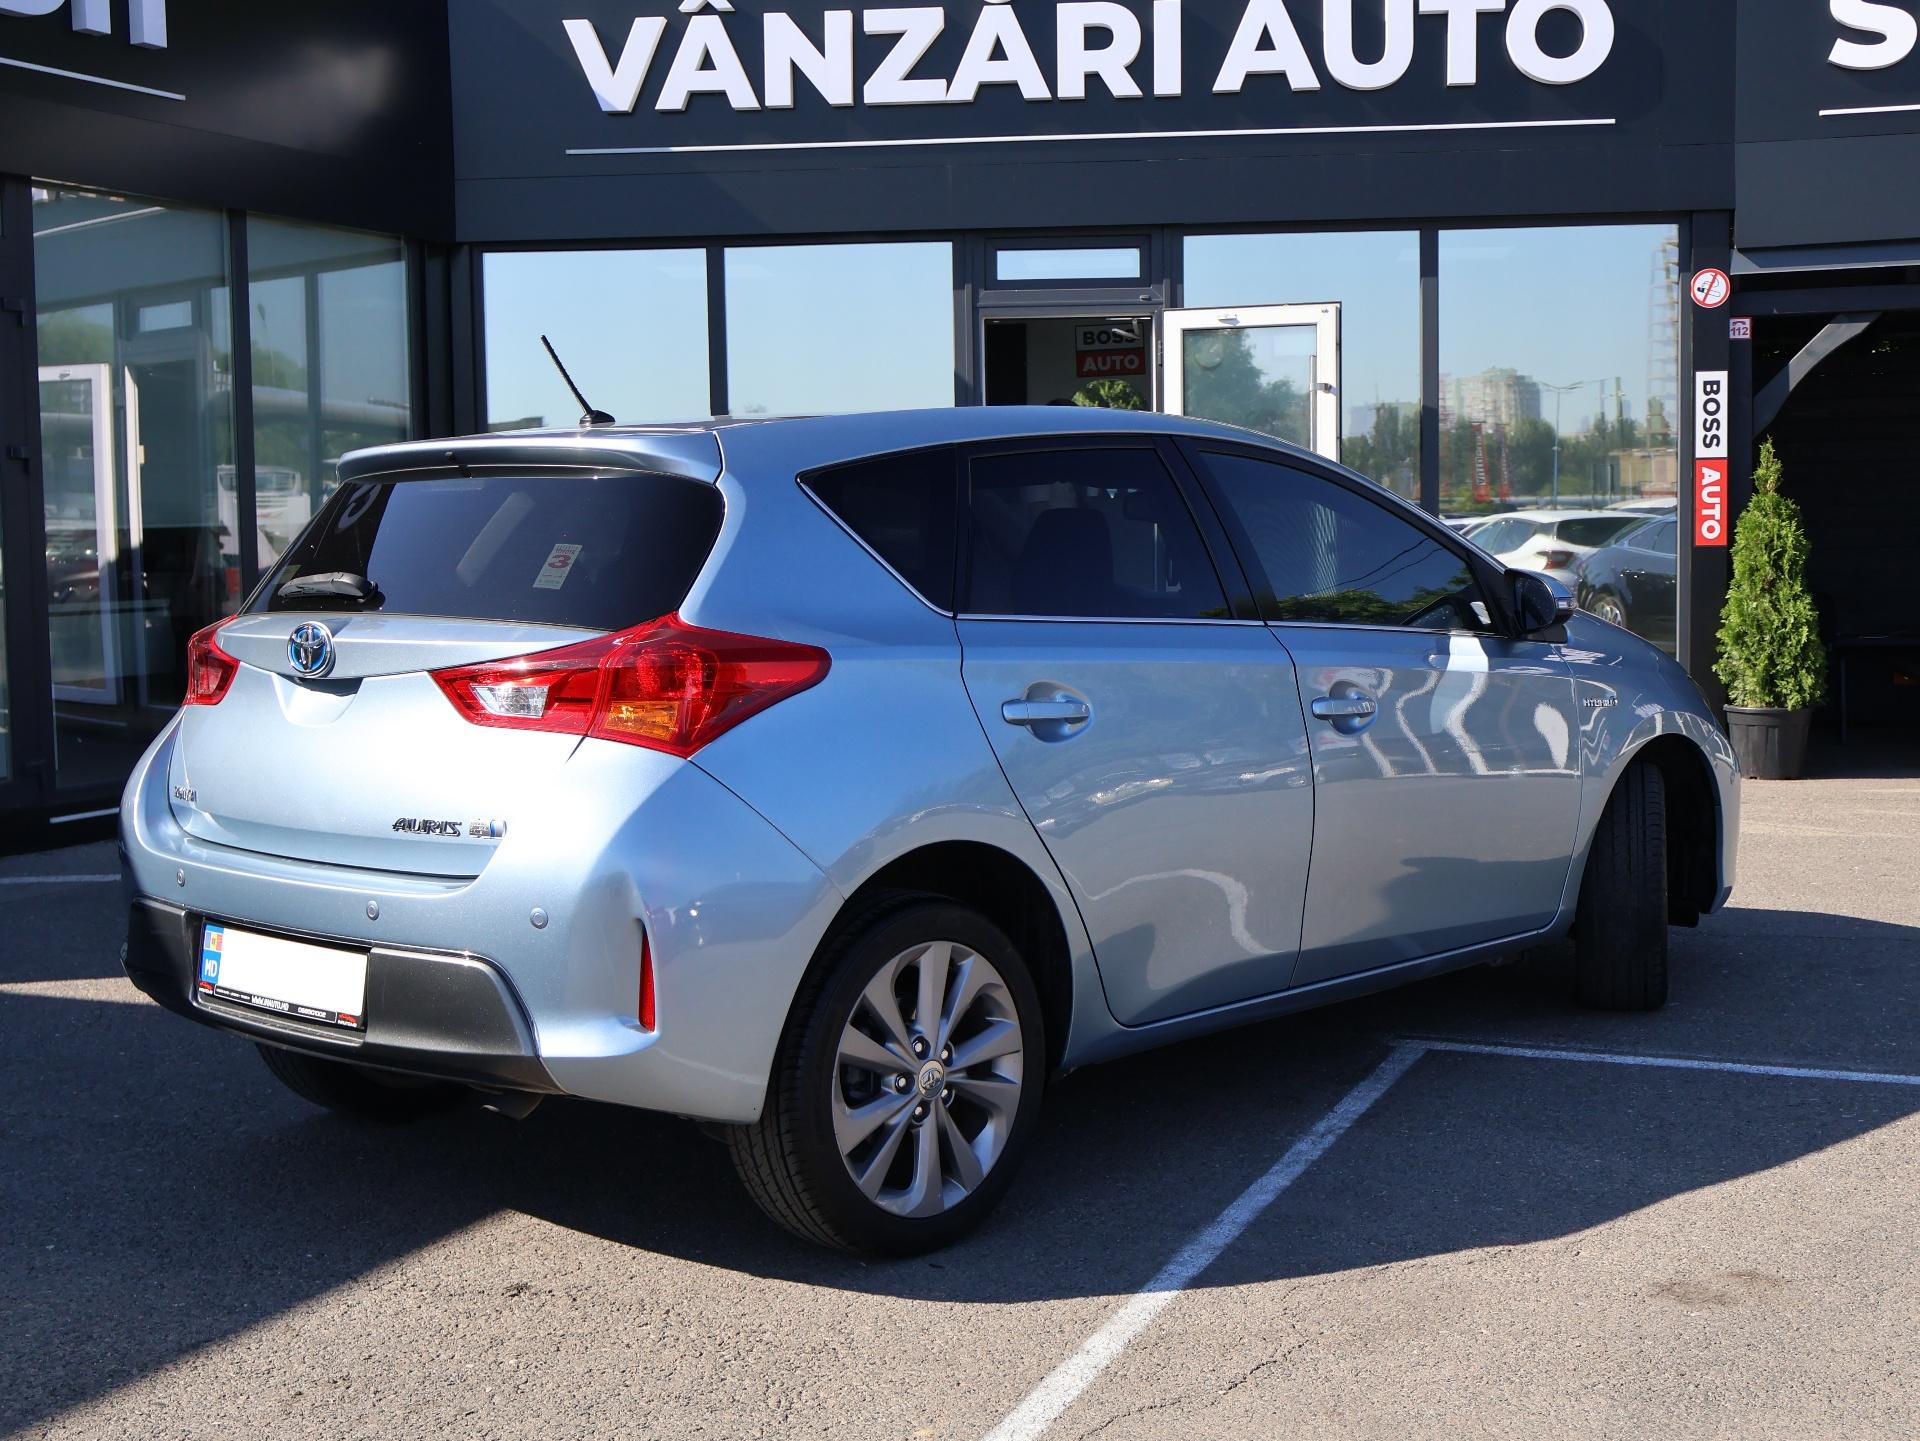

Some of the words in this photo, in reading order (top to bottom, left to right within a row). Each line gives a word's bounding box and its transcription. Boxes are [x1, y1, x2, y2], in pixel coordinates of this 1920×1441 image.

[1212, 0, 1615, 93] AUTO
[1730, 326, 1749, 337] 112
[1082, 354, 1140, 373] AUTO
[1702, 379, 1721, 449] BOSS
[1701, 466, 1721, 540] AUTO
[547, 554, 572, 569] 3
[392, 817, 463, 837] AURIS
[204, 958, 218, 978] MD
